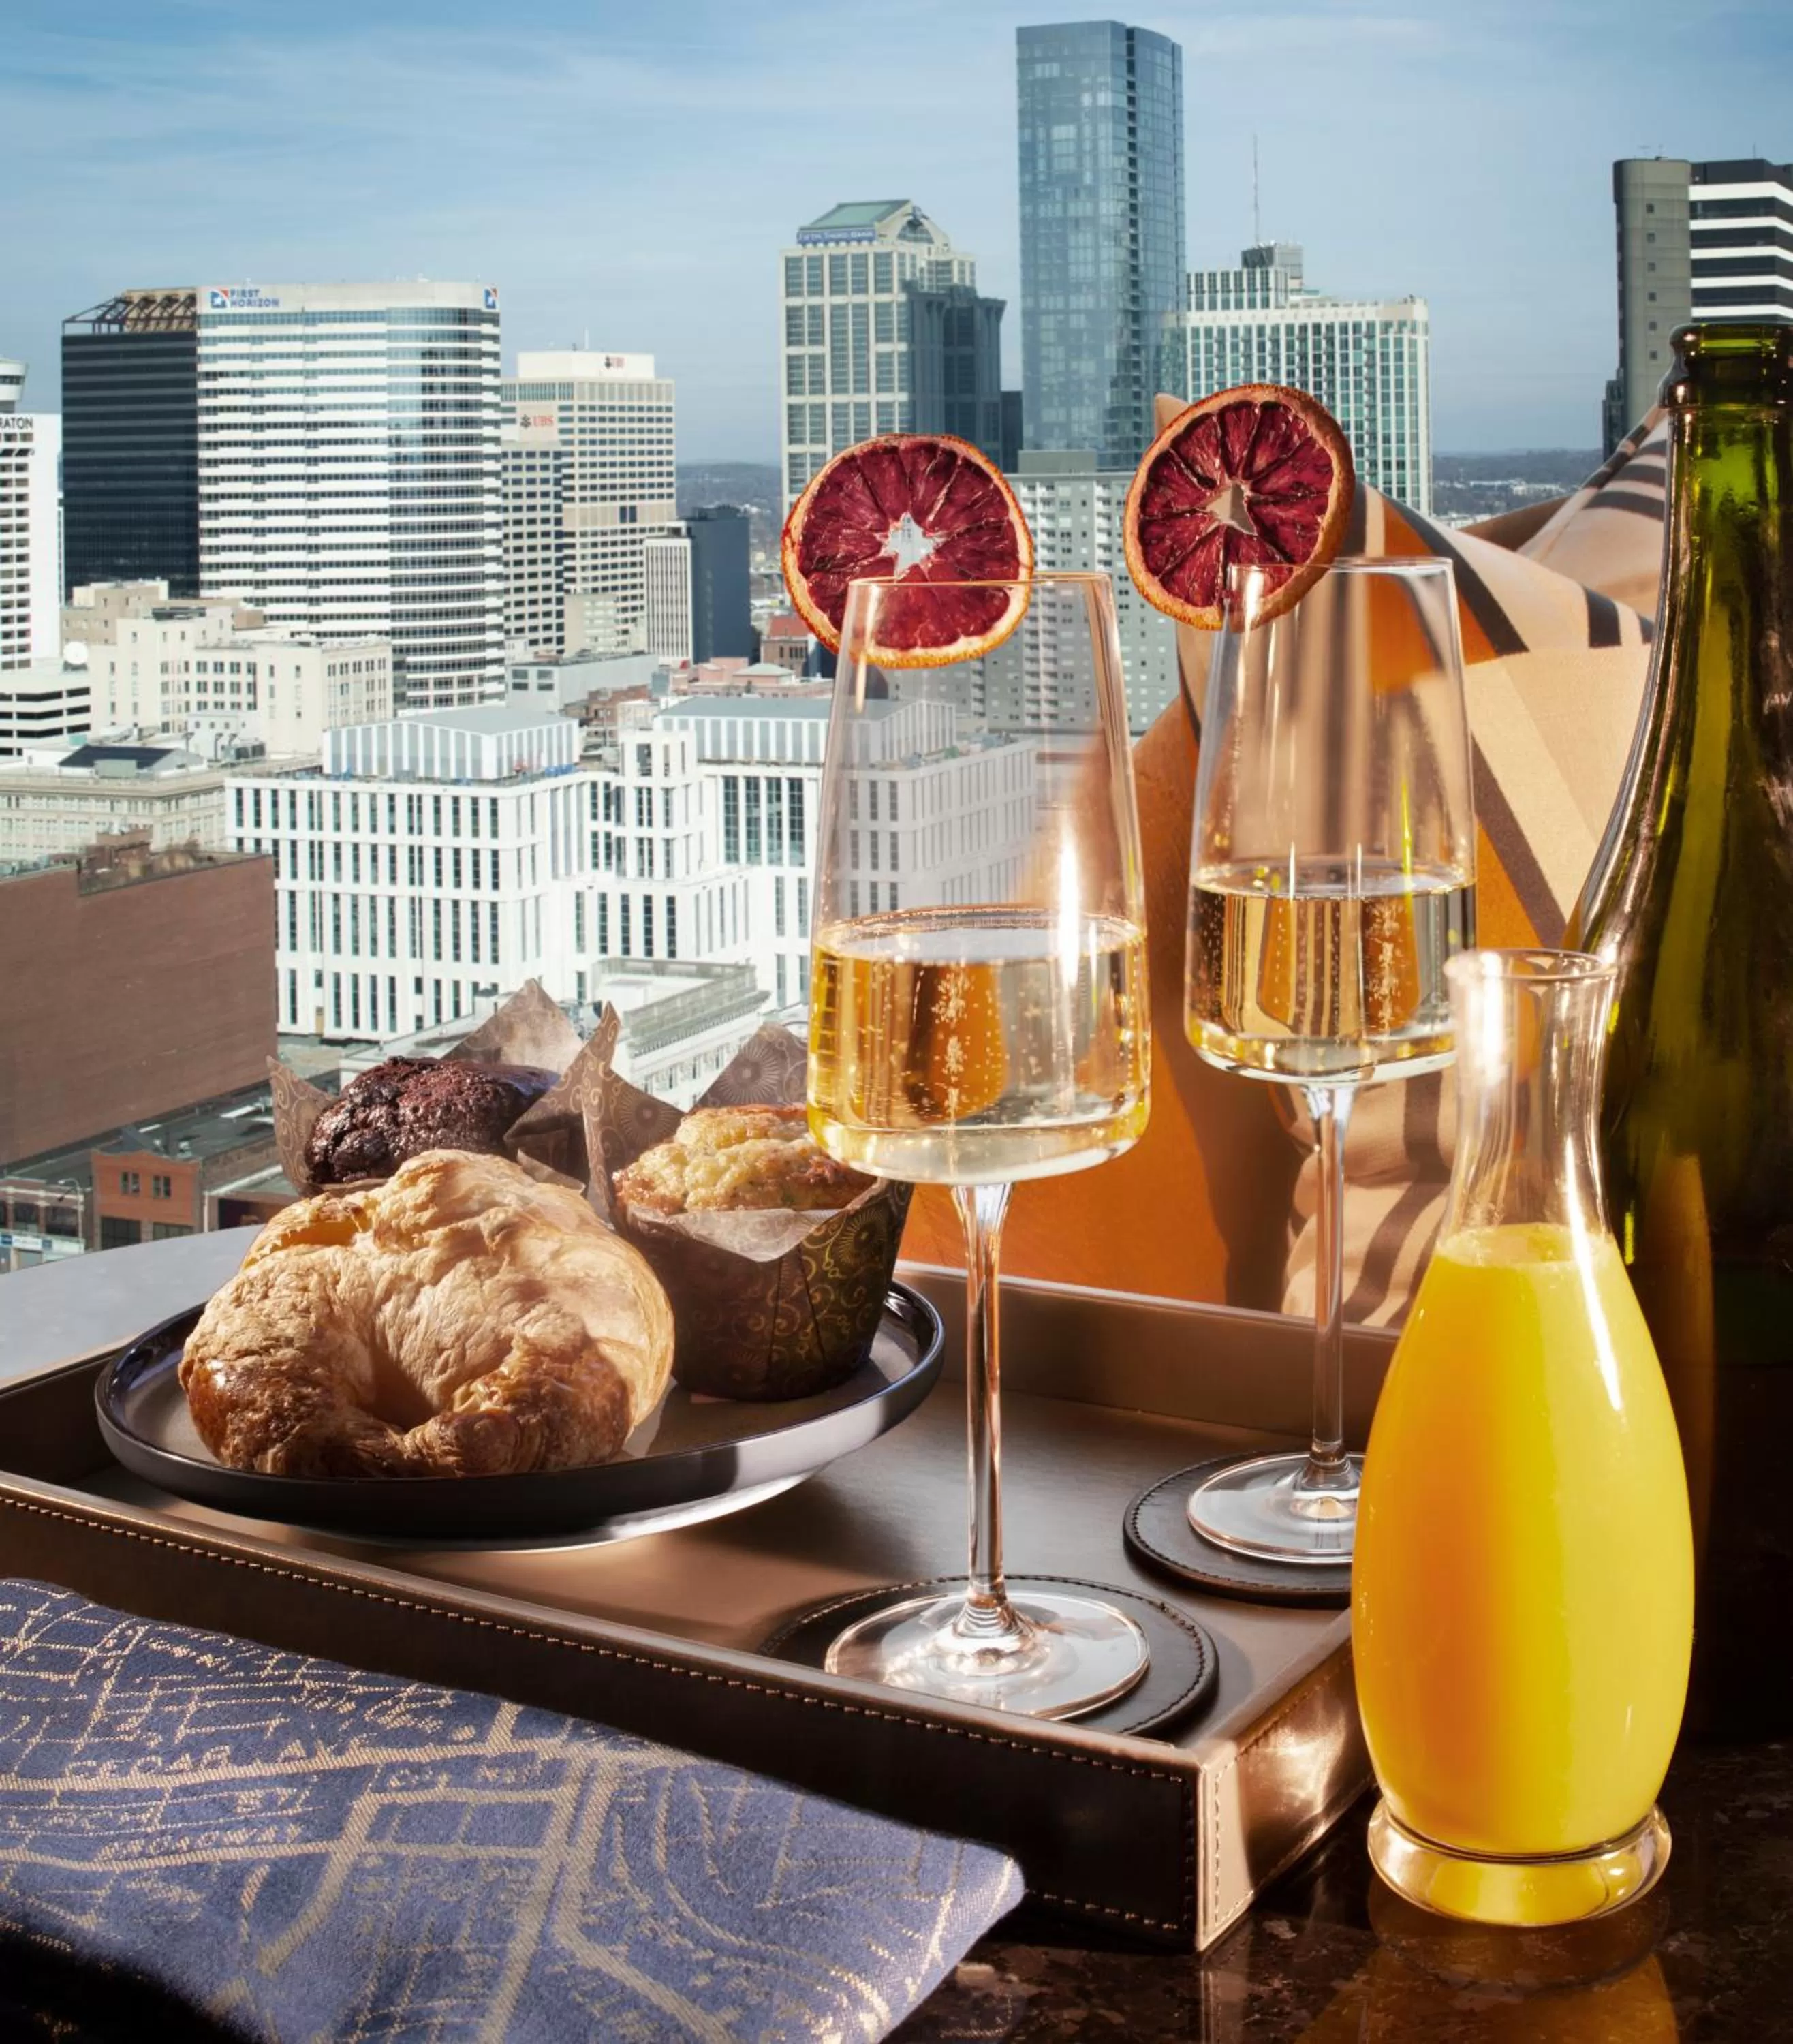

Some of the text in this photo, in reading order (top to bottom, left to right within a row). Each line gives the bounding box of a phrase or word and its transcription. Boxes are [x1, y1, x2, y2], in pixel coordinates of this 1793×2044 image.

[230, 288, 260, 298] FIRST
[230, 298, 280, 307] HORIZON
[533, 415, 554, 427] UBS
